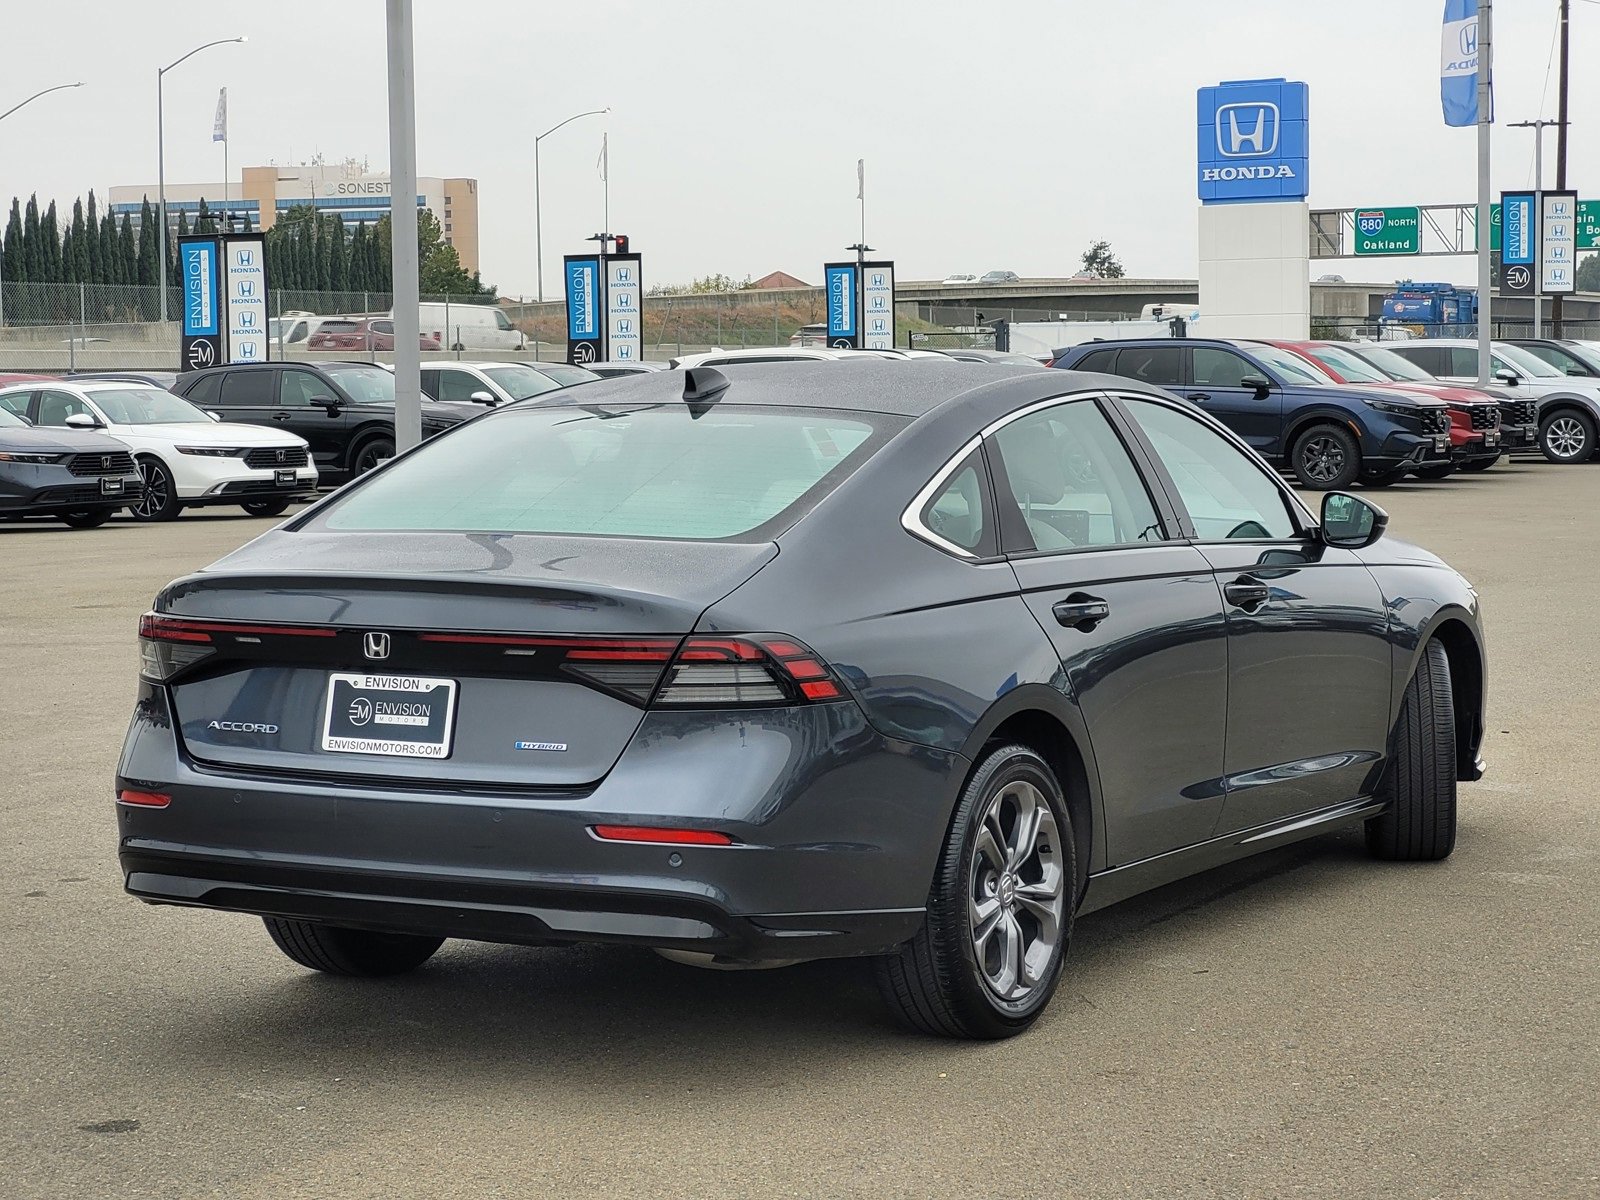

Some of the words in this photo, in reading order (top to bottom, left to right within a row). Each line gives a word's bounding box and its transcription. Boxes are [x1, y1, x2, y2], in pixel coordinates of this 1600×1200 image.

[1202, 165, 1296, 181] HONDA
[337, 182, 391, 194] SONEST
[1361, 219, 1382, 231] 880
[1388, 219, 1417, 227] NORTH
[1509, 201, 1520, 259] ENVISION
[1363, 240, 1410, 250] Oakland
[189, 250, 202, 328] ENVISION
[573, 267, 585, 333] ENVISION
[833, 273, 843, 331] ENVISION
[365, 677, 420, 690] ENVISION
[375, 701, 431, 716] ENVISION
[207, 720, 279, 734] ACCORD
[379, 716, 424, 724] MOTORS
[328, 739, 442, 756] ENVISIONMOTORS.COM
